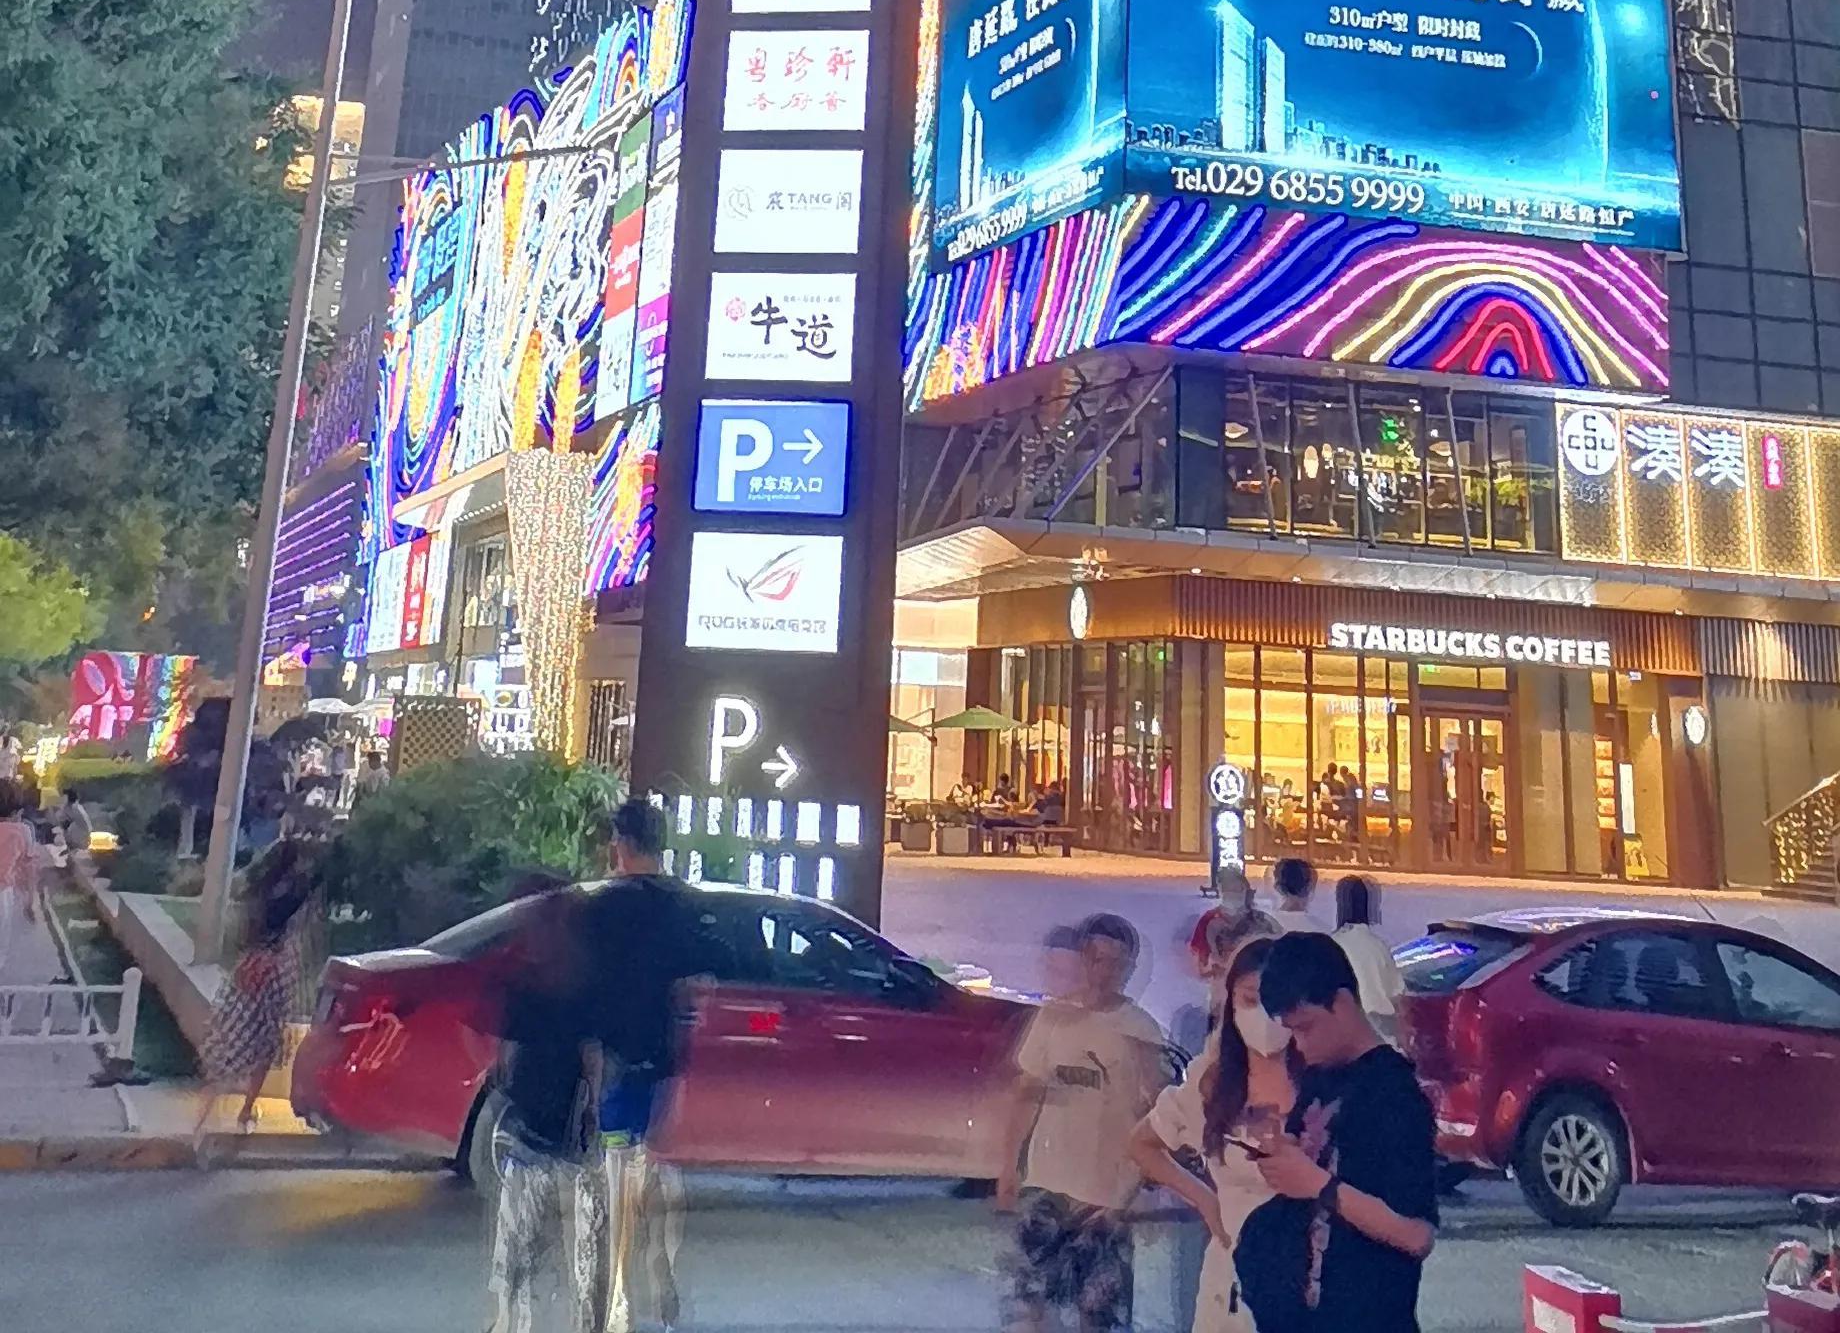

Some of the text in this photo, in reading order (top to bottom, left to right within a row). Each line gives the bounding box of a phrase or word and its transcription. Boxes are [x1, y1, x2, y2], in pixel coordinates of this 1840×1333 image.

[1269, 168, 1345, 206] 6855
[1350, 175, 1426, 214] 9999
[750, 295, 837, 360] 牛道
[717, 418, 774, 502] P
[749, 475, 823, 494] 停车场入口
[1331, 622, 1612, 667] STARBUCKS COFFEE
[710, 696, 758, 785] P
